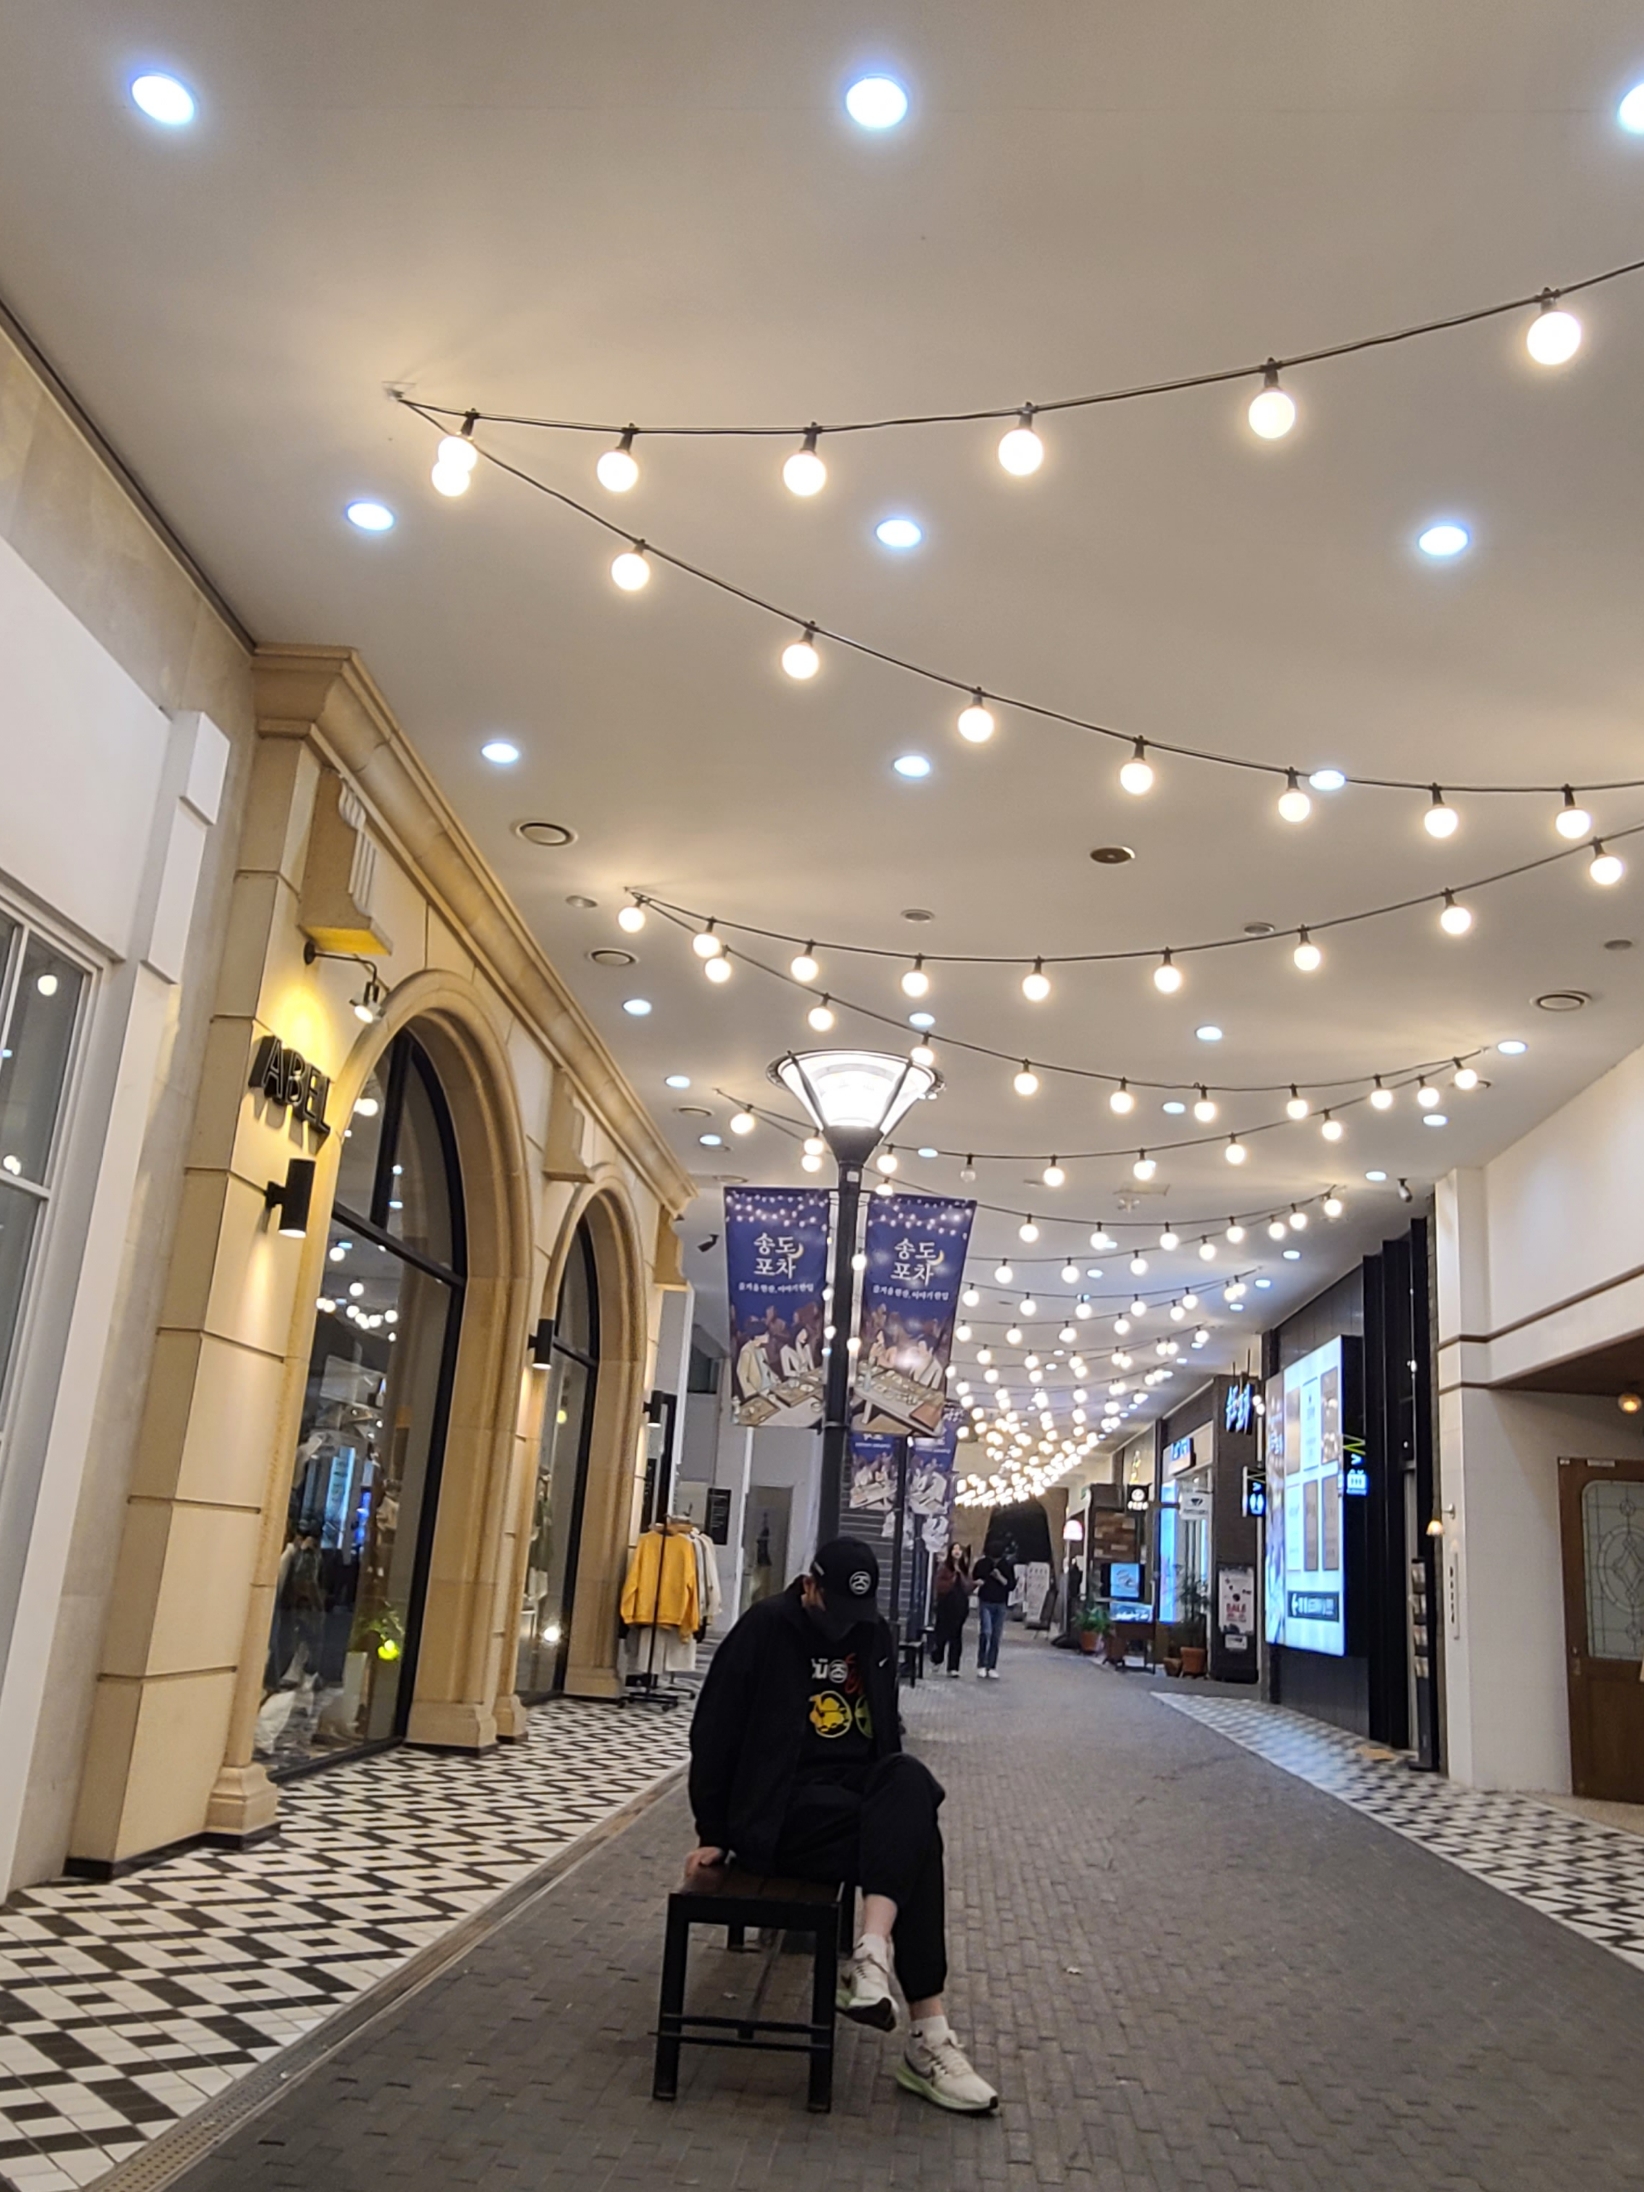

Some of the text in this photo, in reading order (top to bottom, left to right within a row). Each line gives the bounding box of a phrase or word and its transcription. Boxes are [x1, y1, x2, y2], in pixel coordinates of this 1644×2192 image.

[249, 1035, 331, 1134] ABEL
[754, 1232, 797, 1255] 송도
[894, 1238, 937, 1262] 송도
[753, 1257, 797, 1279] 포차
[890, 1263, 934, 1286] 포차
